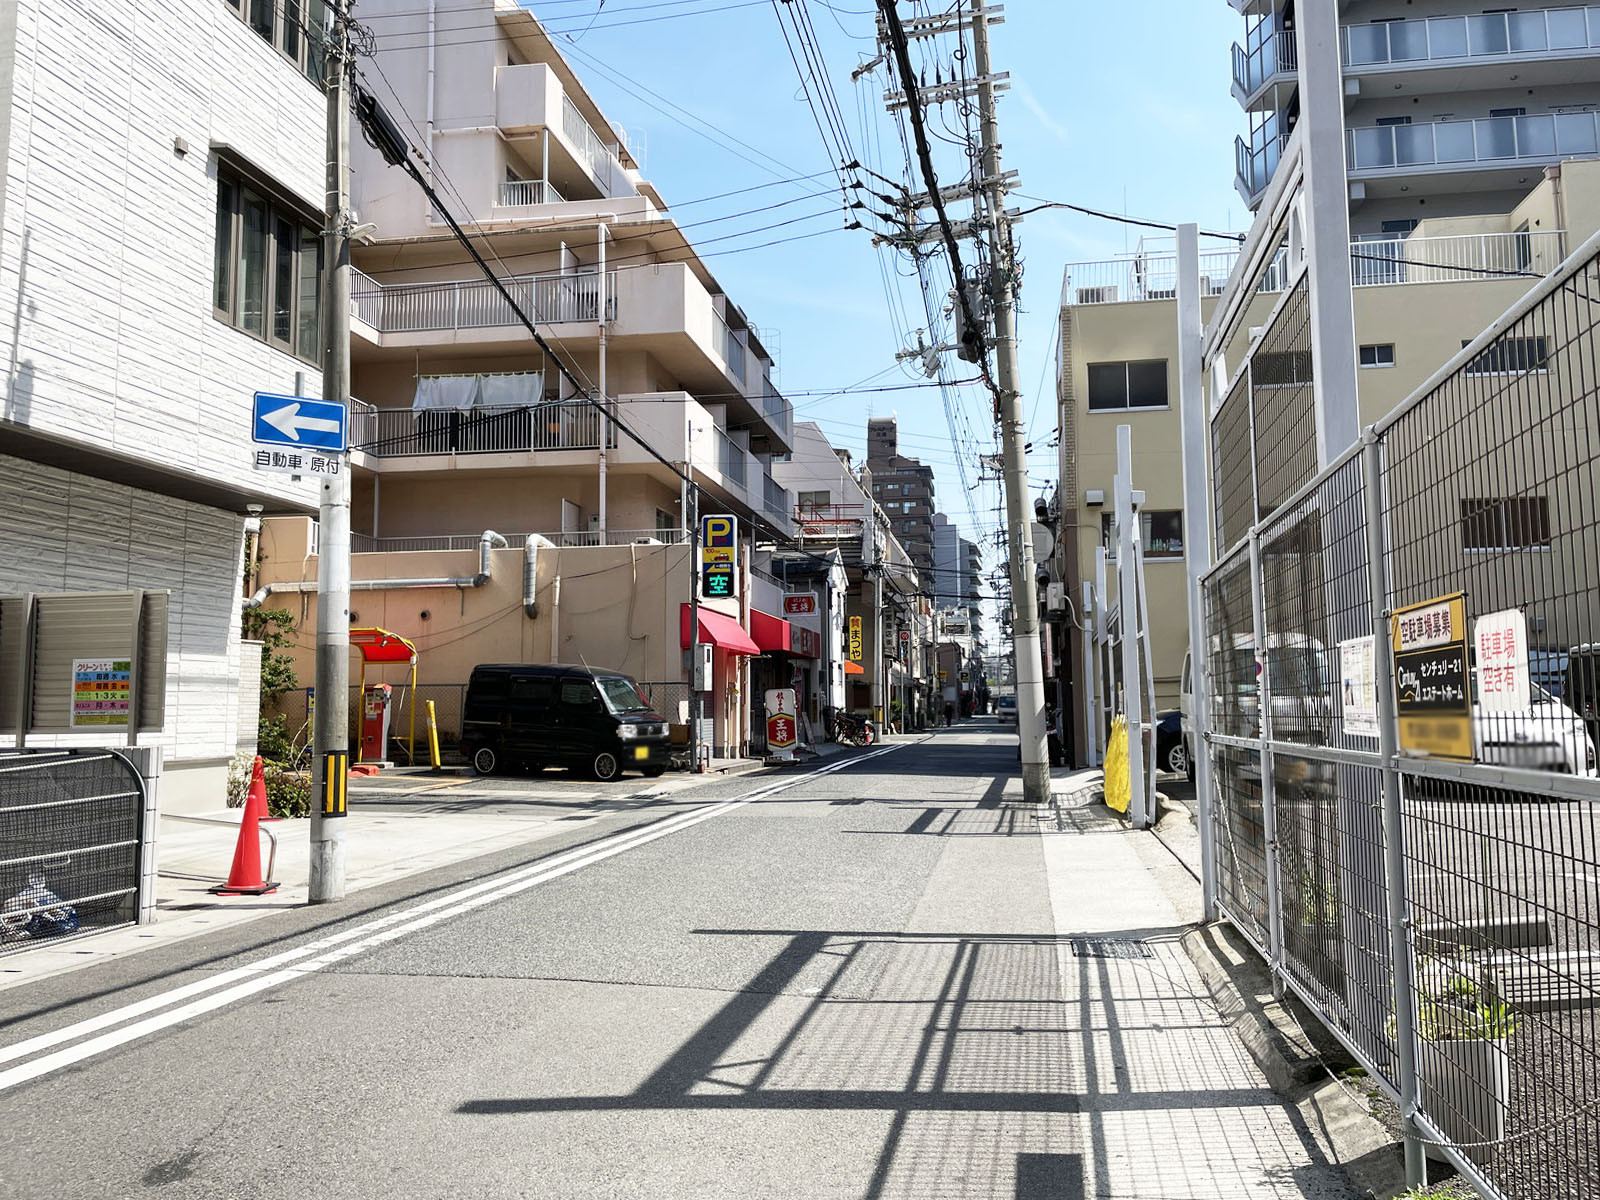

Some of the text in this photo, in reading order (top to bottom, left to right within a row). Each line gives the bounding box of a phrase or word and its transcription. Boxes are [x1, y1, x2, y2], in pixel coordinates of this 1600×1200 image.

[256, 450, 340, 474] 自動車・原付
[707, 518, 731, 547] P
[709, 574, 729, 594] 空
[1400, 610, 1451, 645] 空駐車場募集
[1480, 628, 1515, 661] 駐車場
[77, 663, 98, 672] クリーン
[1420, 658, 1462, 677] センチュリー21
[1483, 662, 1515, 694] 空き有
[1422, 683, 1463, 701] エステートホーム
[776, 719, 787, 741] 王将
